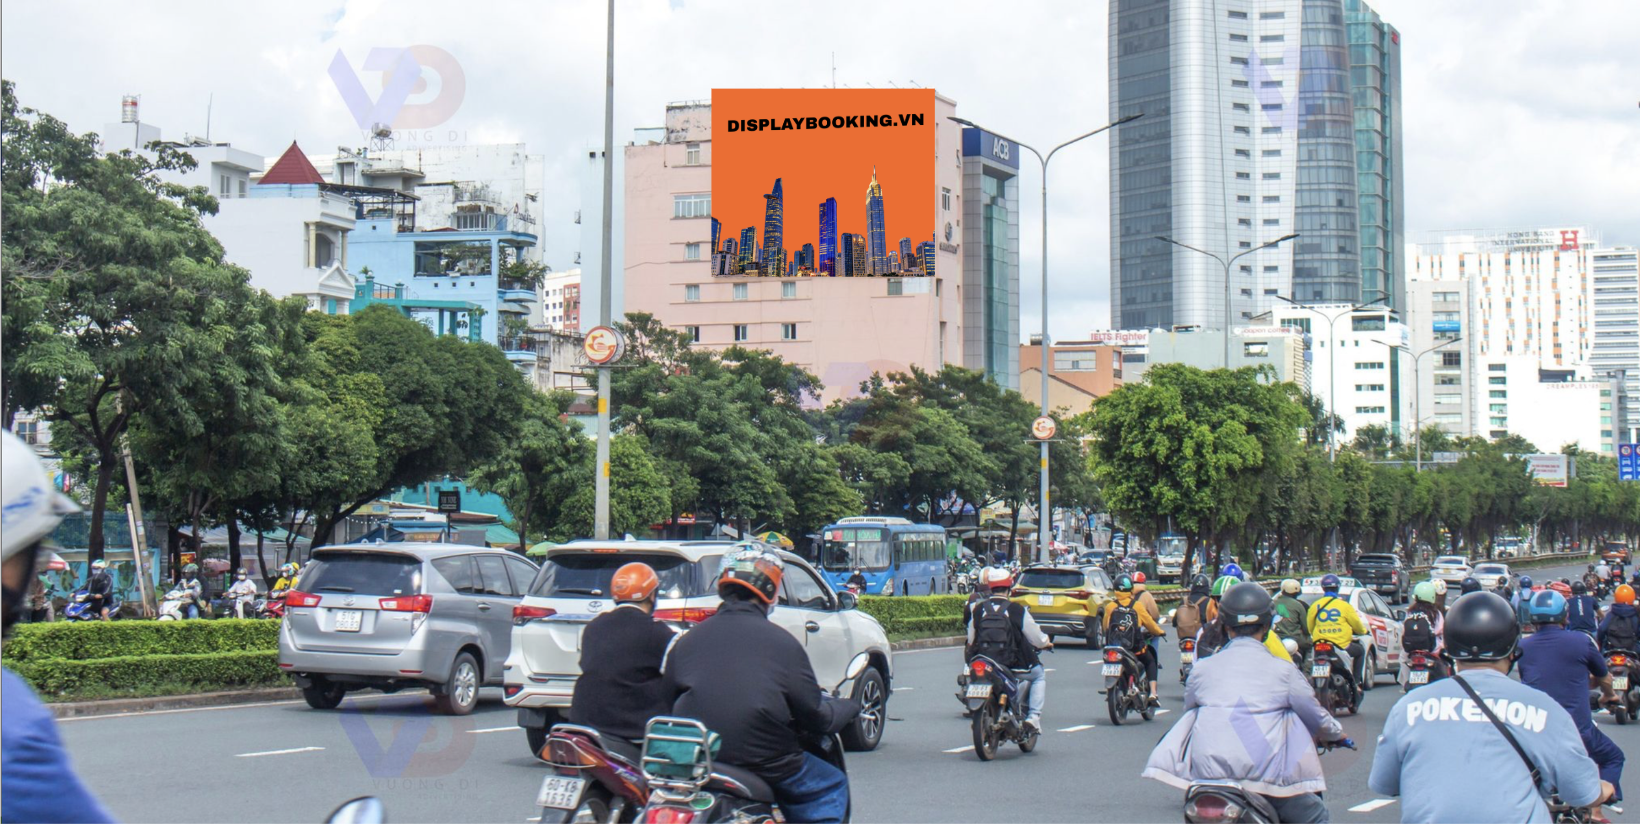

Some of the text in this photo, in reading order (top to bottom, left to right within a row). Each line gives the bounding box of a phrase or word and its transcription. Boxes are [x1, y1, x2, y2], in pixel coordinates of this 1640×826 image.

[727, 113, 925, 133] DISPLAYBOOKING.VN
[992, 137, 1009, 161] ACB
[1090, 332, 1146, 343] IELTS Fighter
[1316, 604, 1342, 623] be
